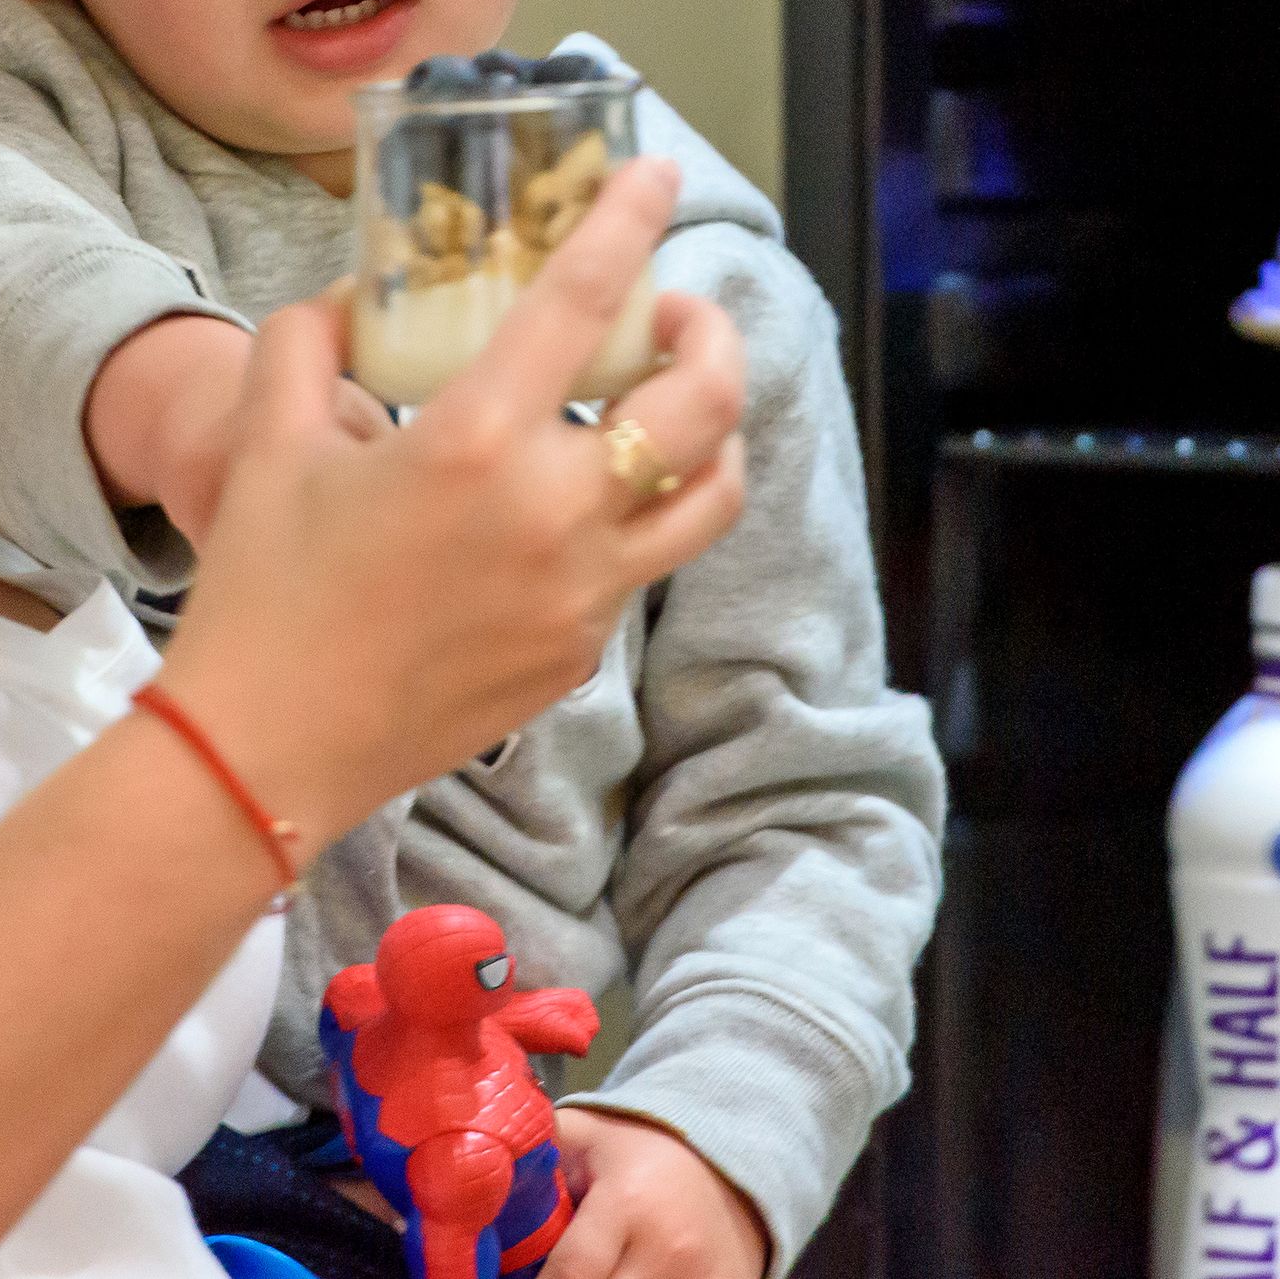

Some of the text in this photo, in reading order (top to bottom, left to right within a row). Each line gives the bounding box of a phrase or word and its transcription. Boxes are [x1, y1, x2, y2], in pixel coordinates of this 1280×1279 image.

[1202, 931, 1280, 1279] LF & HALF
